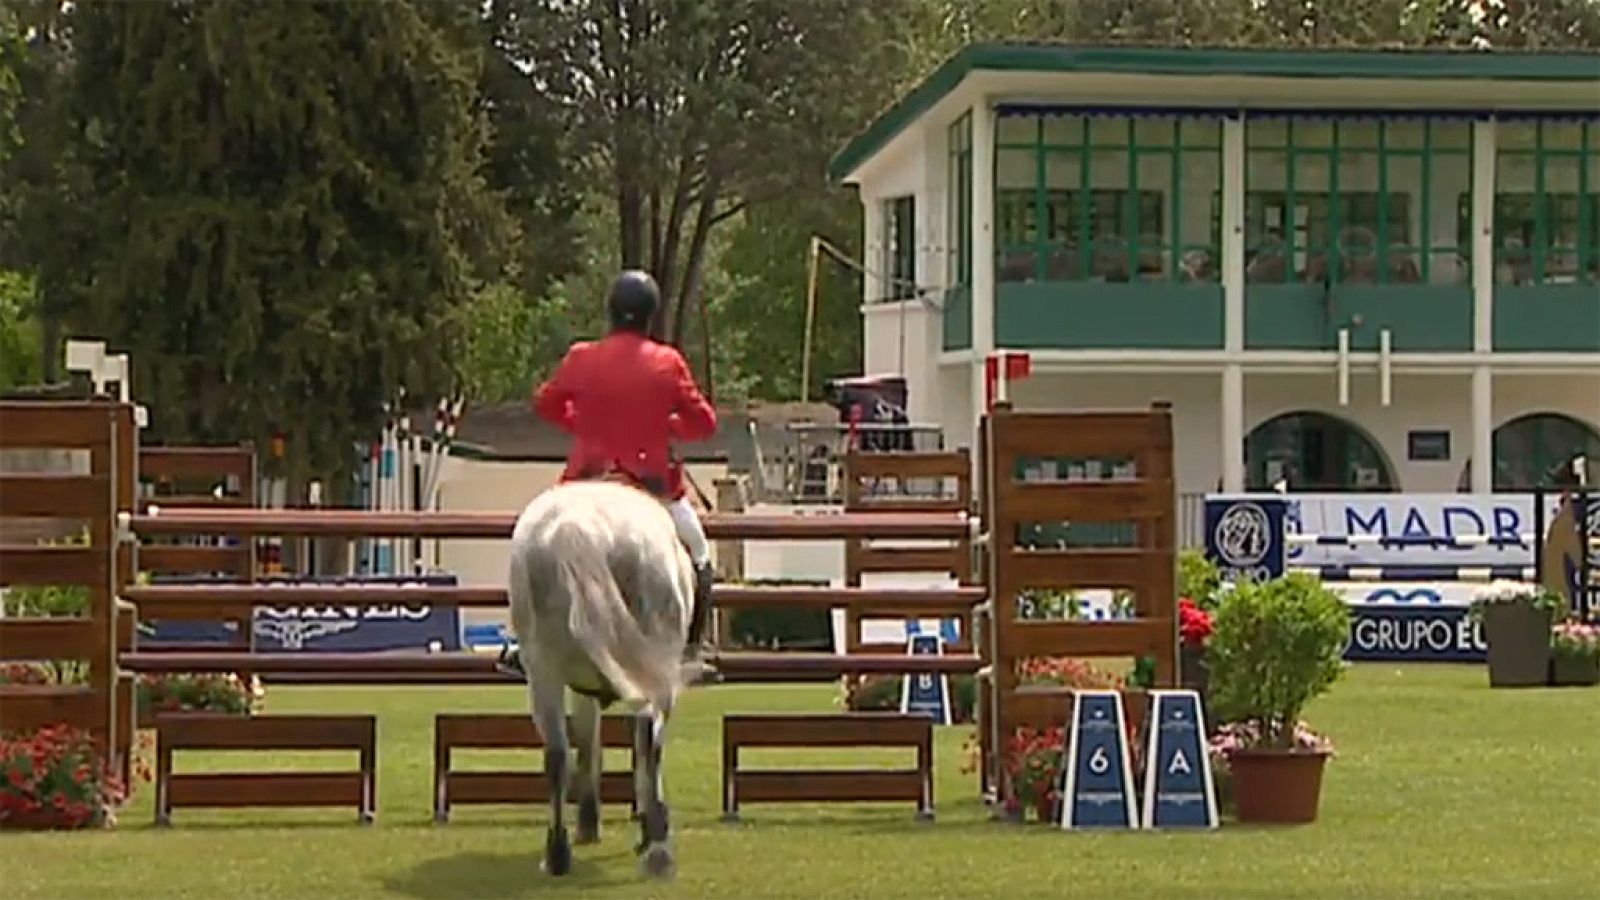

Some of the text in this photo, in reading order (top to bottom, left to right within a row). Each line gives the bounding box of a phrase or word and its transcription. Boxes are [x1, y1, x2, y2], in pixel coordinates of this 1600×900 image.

[1356, 619, 1452, 650] GRUPO
[1089, 746, 1109, 773] 6
[1168, 749, 1191, 774] A
